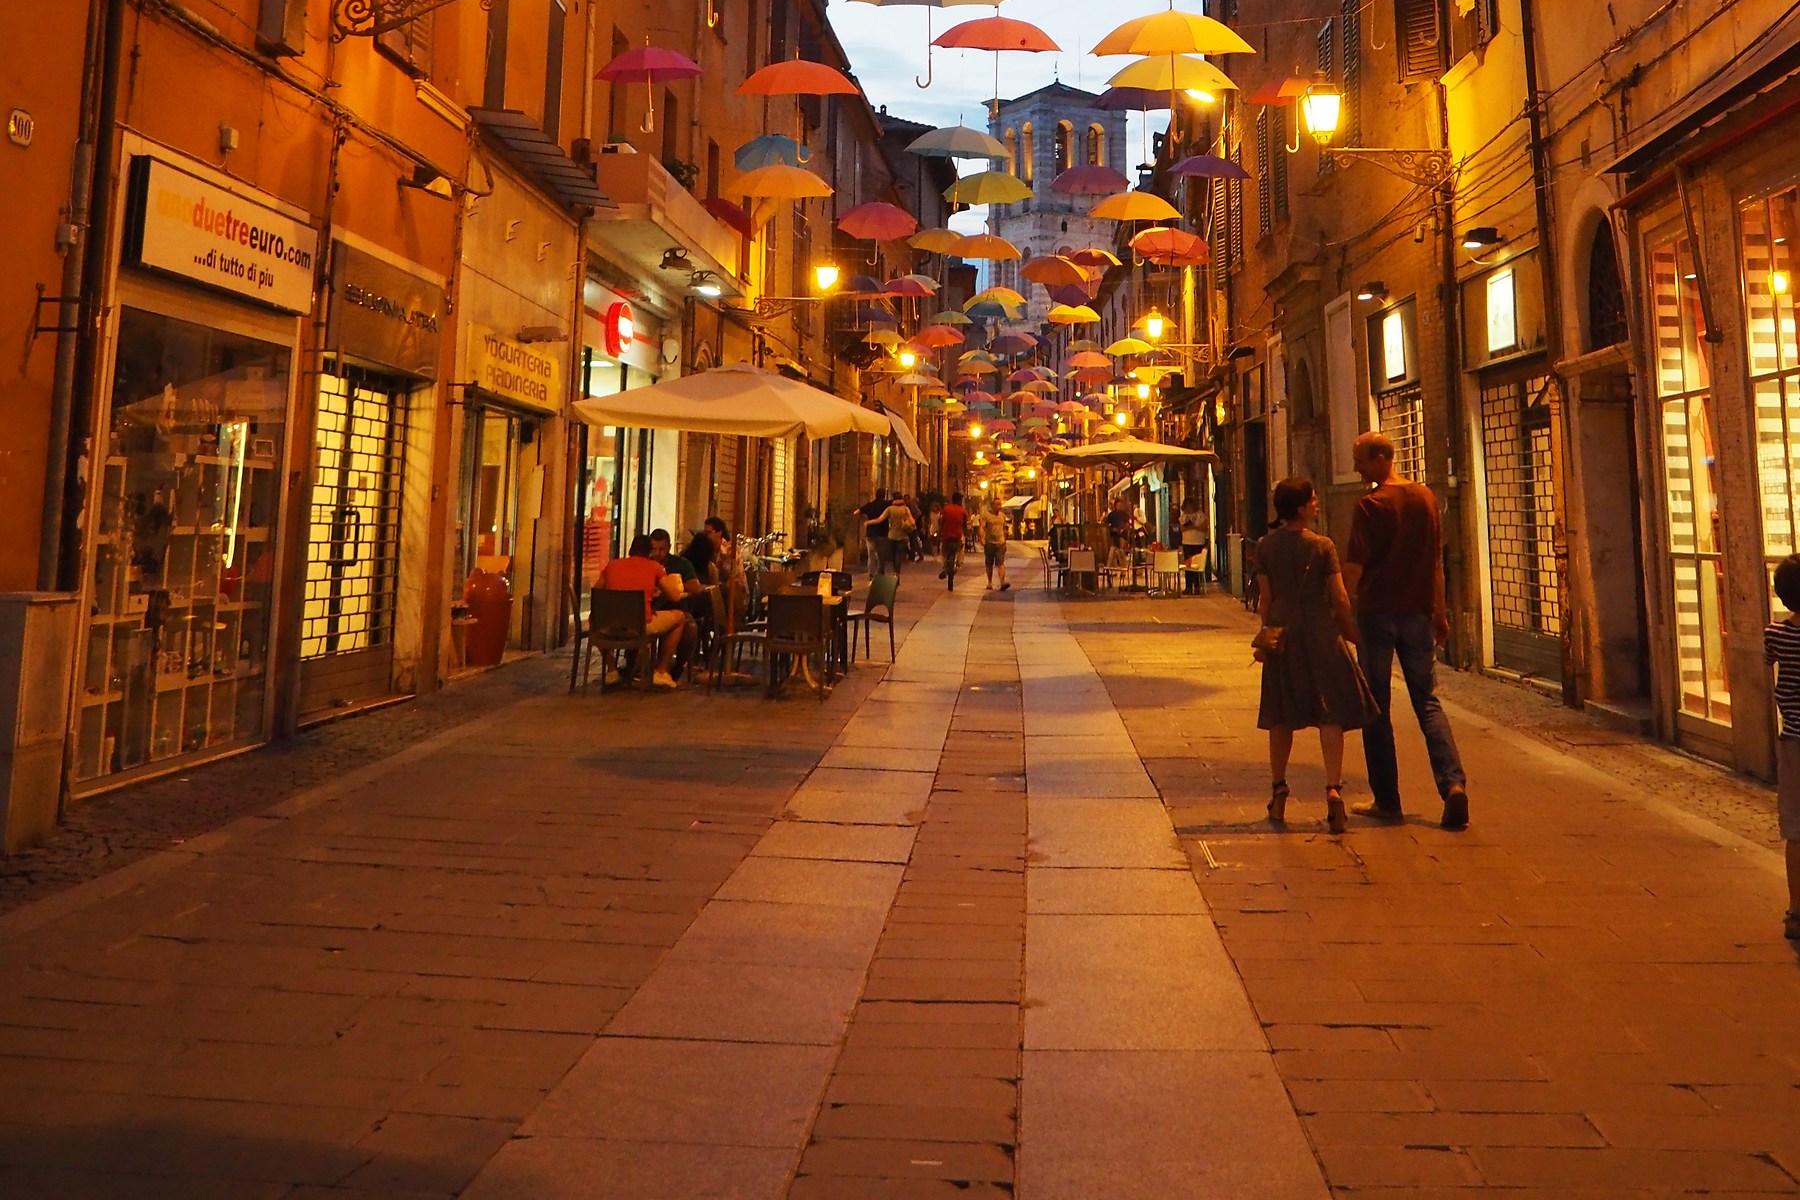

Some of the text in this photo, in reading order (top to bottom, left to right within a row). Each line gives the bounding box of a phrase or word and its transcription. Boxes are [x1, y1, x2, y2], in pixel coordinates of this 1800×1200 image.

[220, 254, 244, 278] tutto
[247, 262, 256, 282] di
[258, 268, 274, 289] piu
